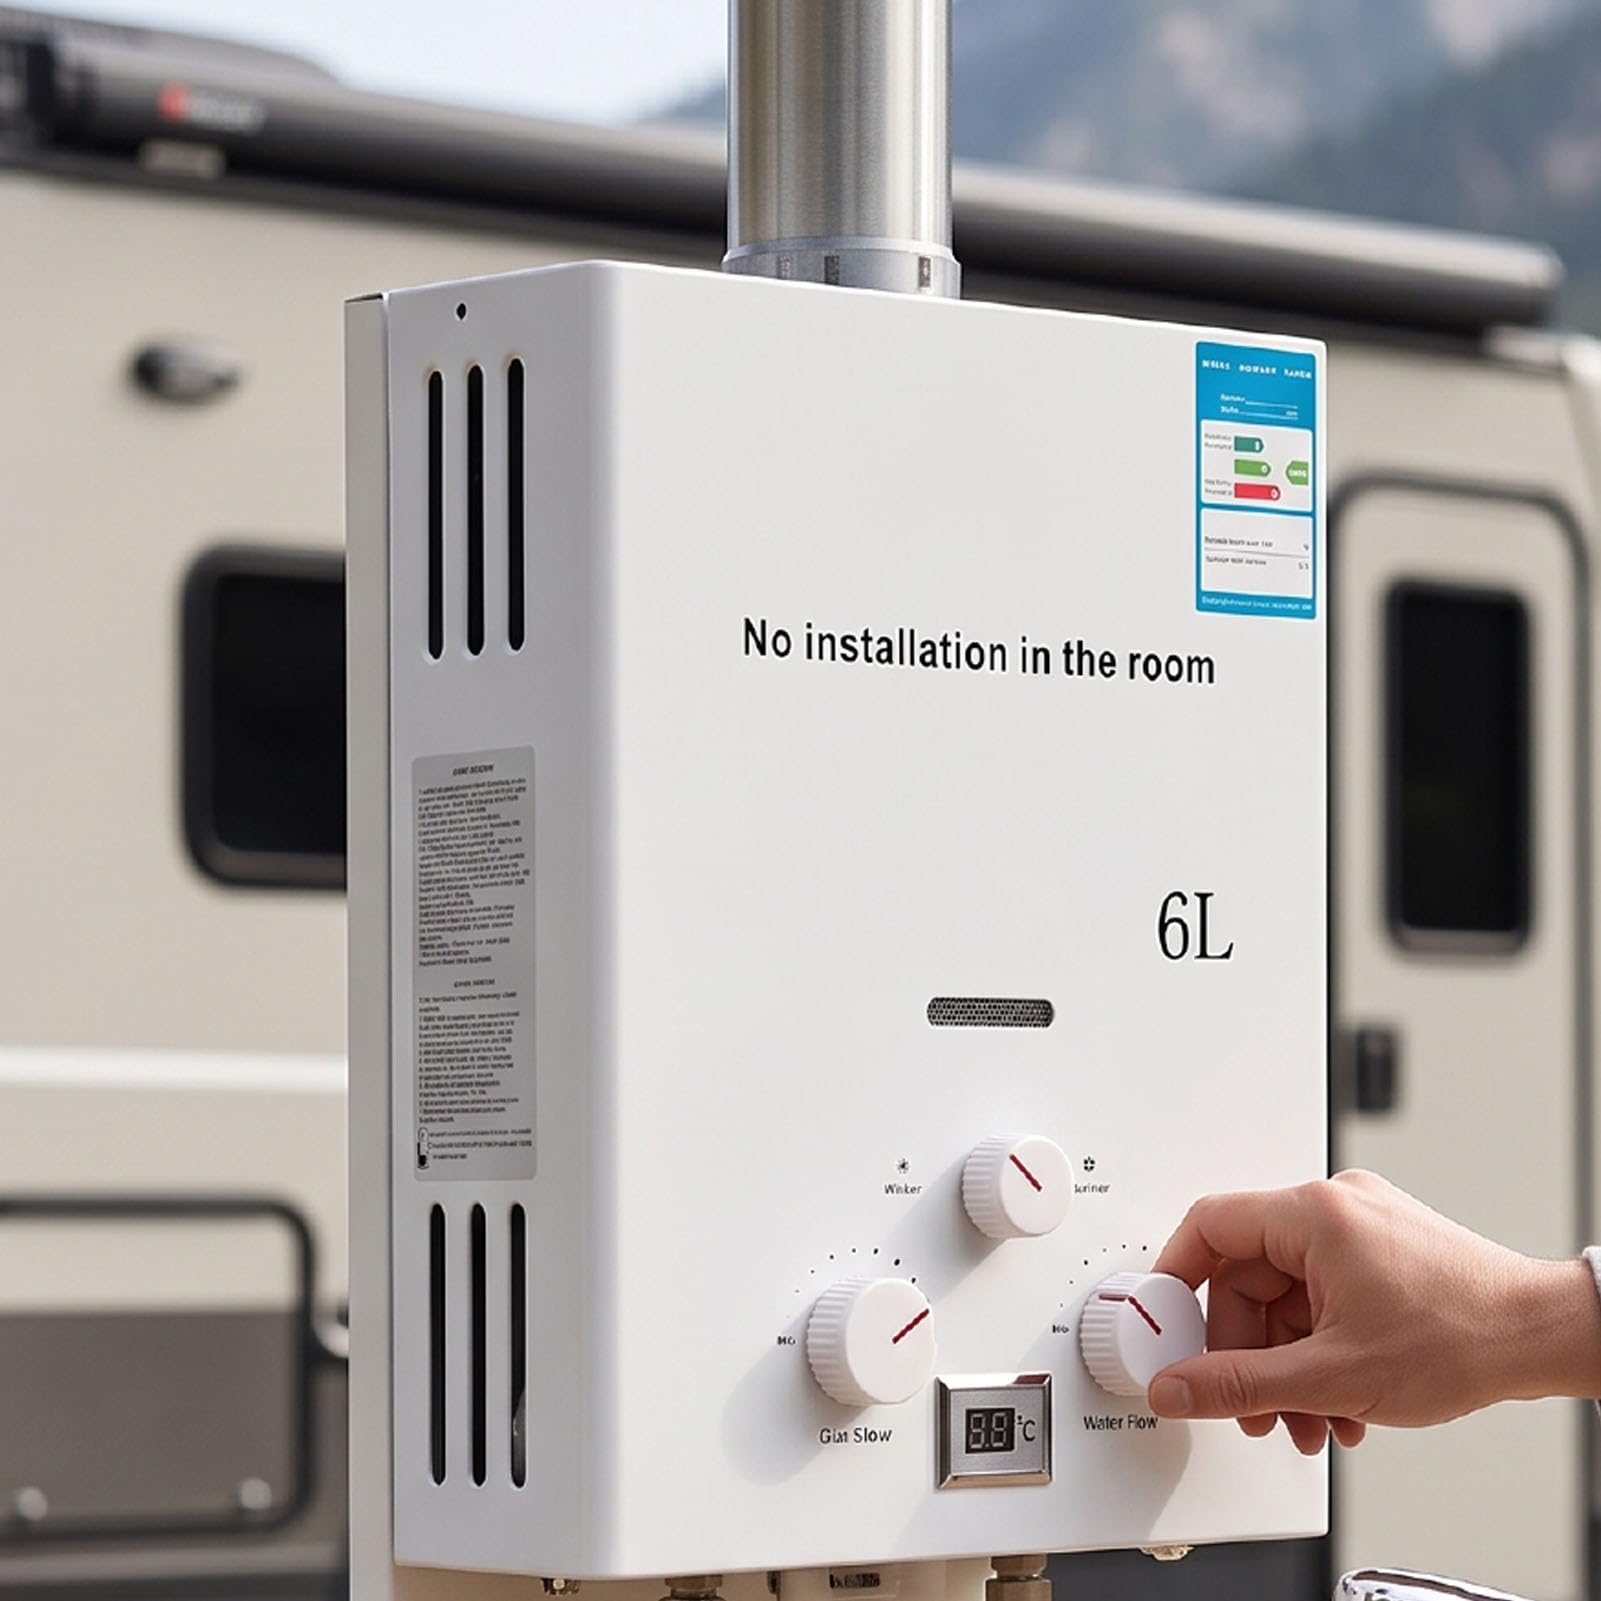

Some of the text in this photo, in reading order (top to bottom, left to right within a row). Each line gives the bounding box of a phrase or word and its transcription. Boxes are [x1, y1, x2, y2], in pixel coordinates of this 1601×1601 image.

[744, 617, 1215, 684] No installation in the room
[1158, 890, 1234, 961] 6L
[853, 1427, 893, 1444] Slow
[1083, 1414, 1159, 1431] Water Flow
